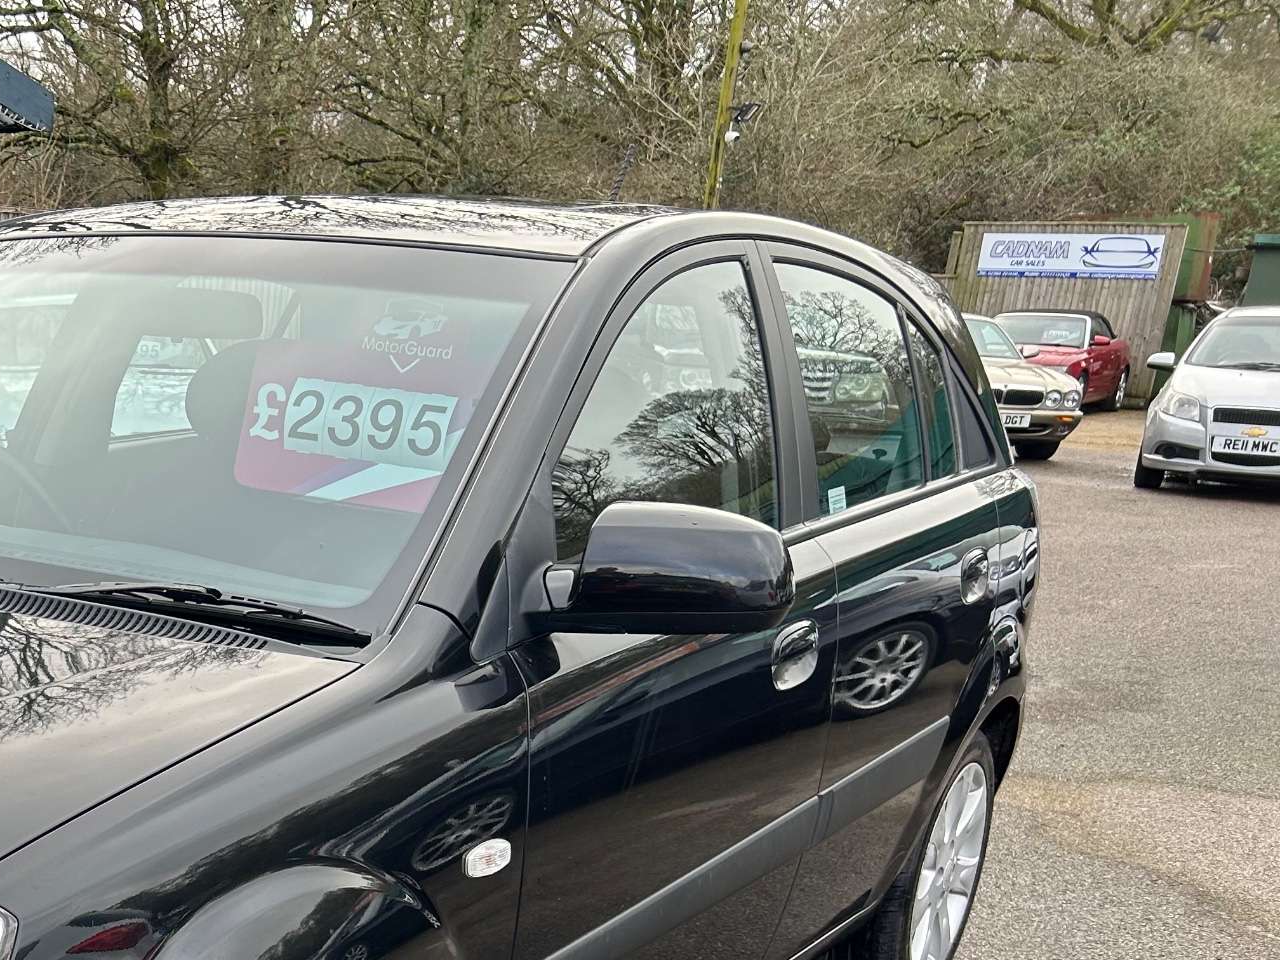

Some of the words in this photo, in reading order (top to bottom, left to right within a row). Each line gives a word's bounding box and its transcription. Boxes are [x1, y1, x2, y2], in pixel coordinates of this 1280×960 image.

[989, 240, 1070, 259] CADNAM
[362, 336, 453, 360] MotorGuard
[249, 383, 448, 456] £2395
[1004, 415, 1025, 426] DGT
[1251, 440, 1279, 453] MWC
